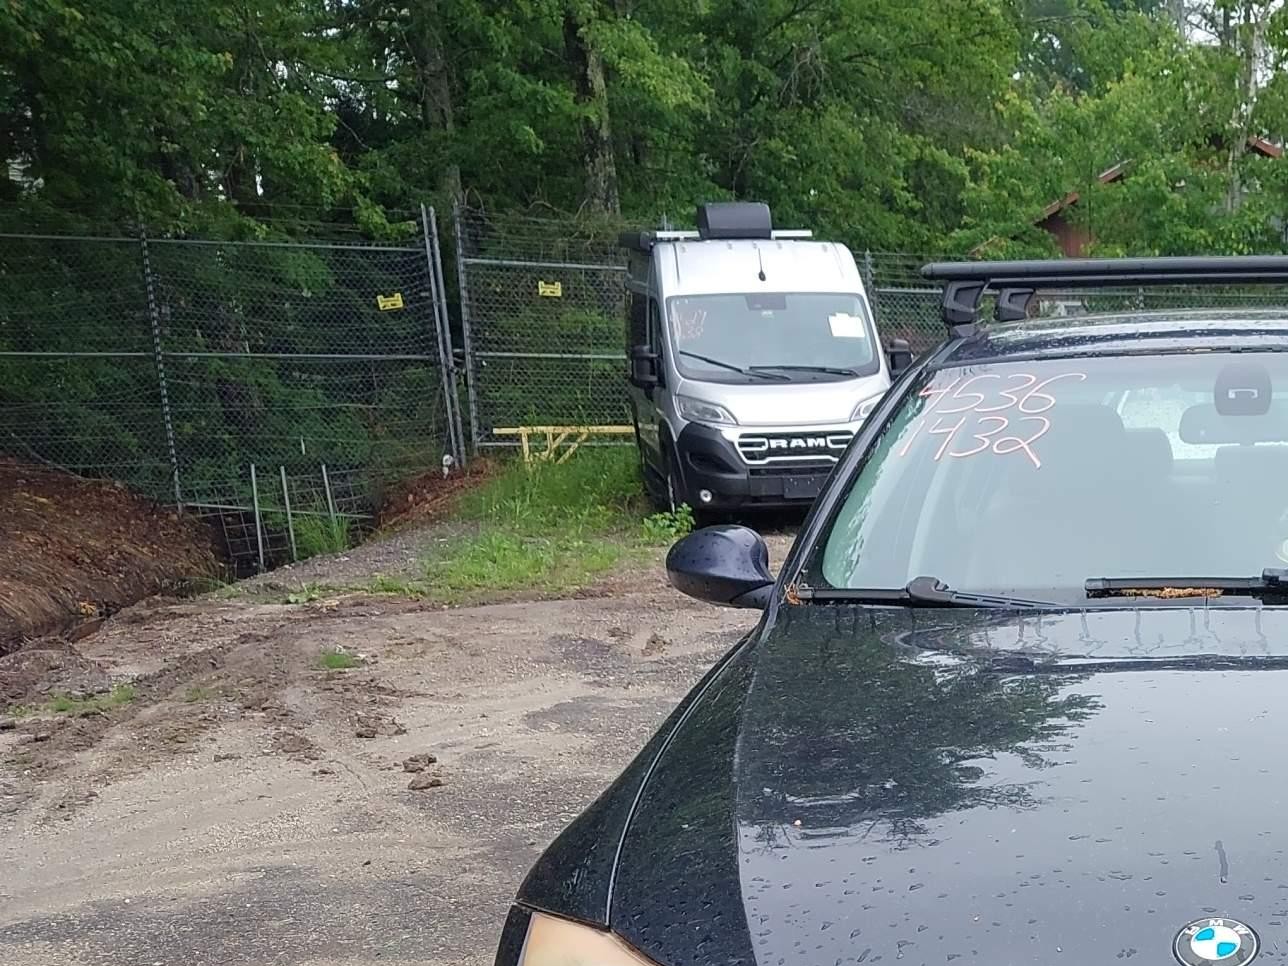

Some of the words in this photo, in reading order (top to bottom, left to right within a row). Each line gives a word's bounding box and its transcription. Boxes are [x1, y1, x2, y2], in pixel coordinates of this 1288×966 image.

[919, 373, 1087, 415] 4536
[769, 437, 826, 449] RAM
[900, 416, 1042, 469] 1432
[1184, 919, 1250, 936] BMW
